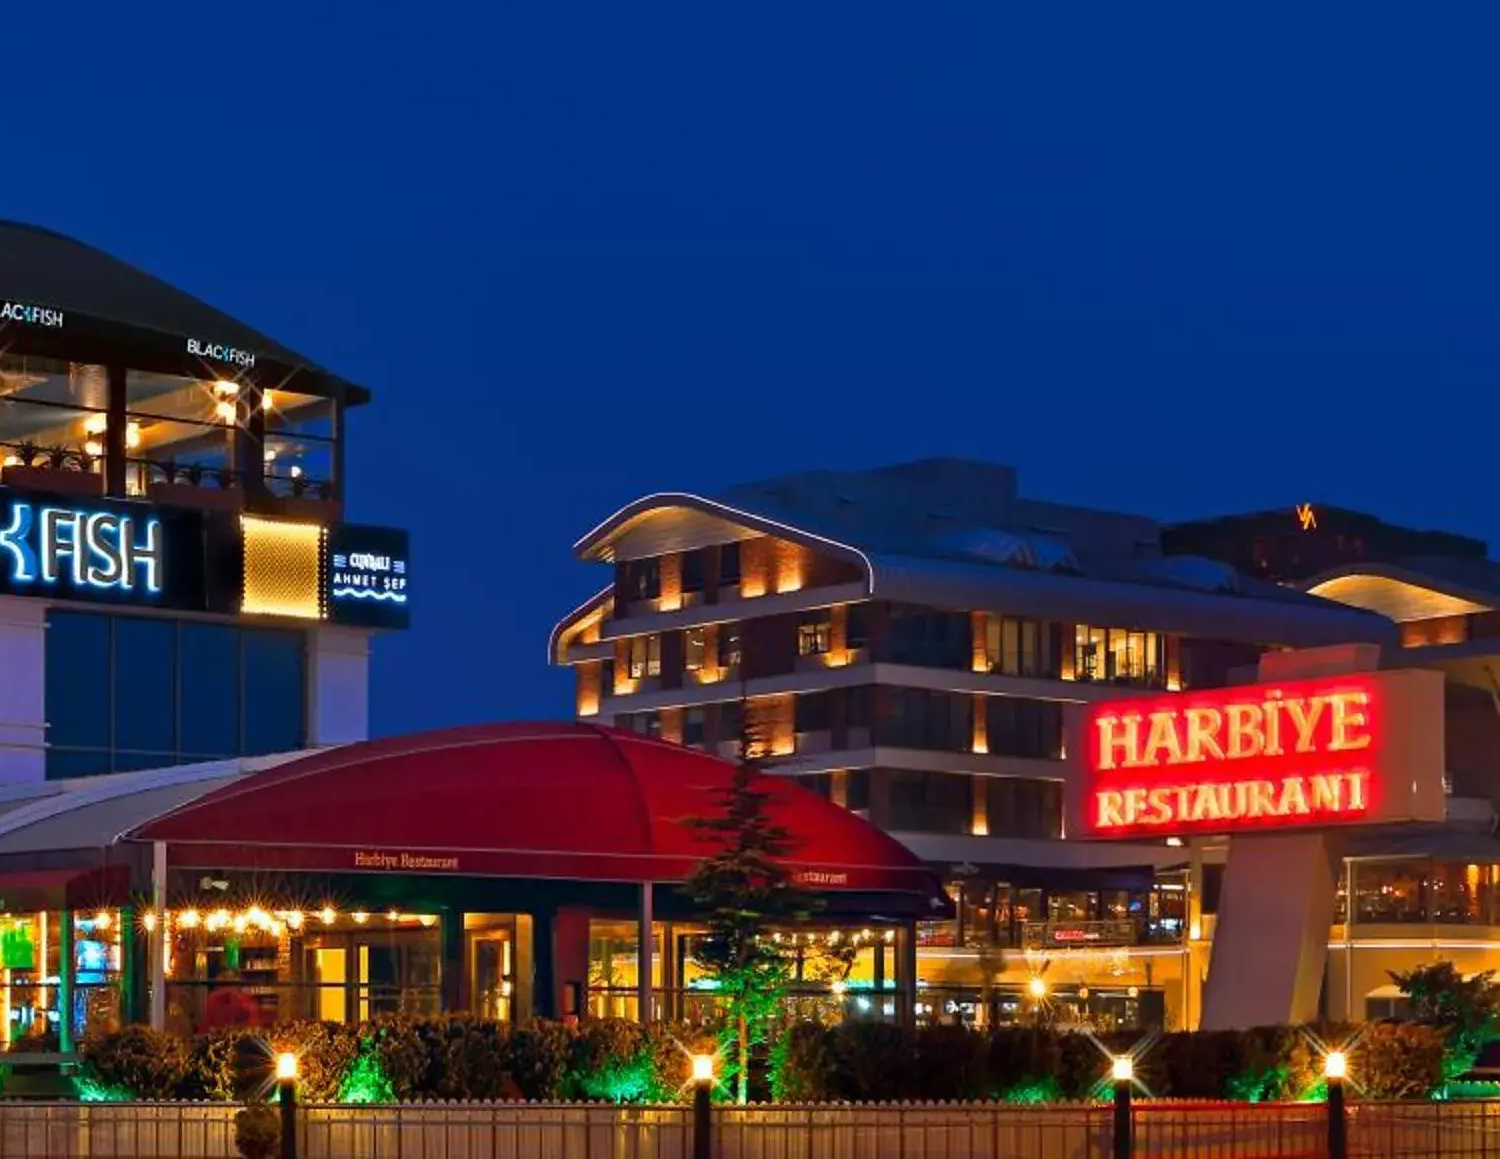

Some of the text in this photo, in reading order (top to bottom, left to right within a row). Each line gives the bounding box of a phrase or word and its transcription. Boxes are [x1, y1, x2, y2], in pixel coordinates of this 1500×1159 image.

[333, 572, 377, 587] AHMET
[1095, 688, 1372, 770] HARBİYE
[400, 852, 459, 870] Restaurant
